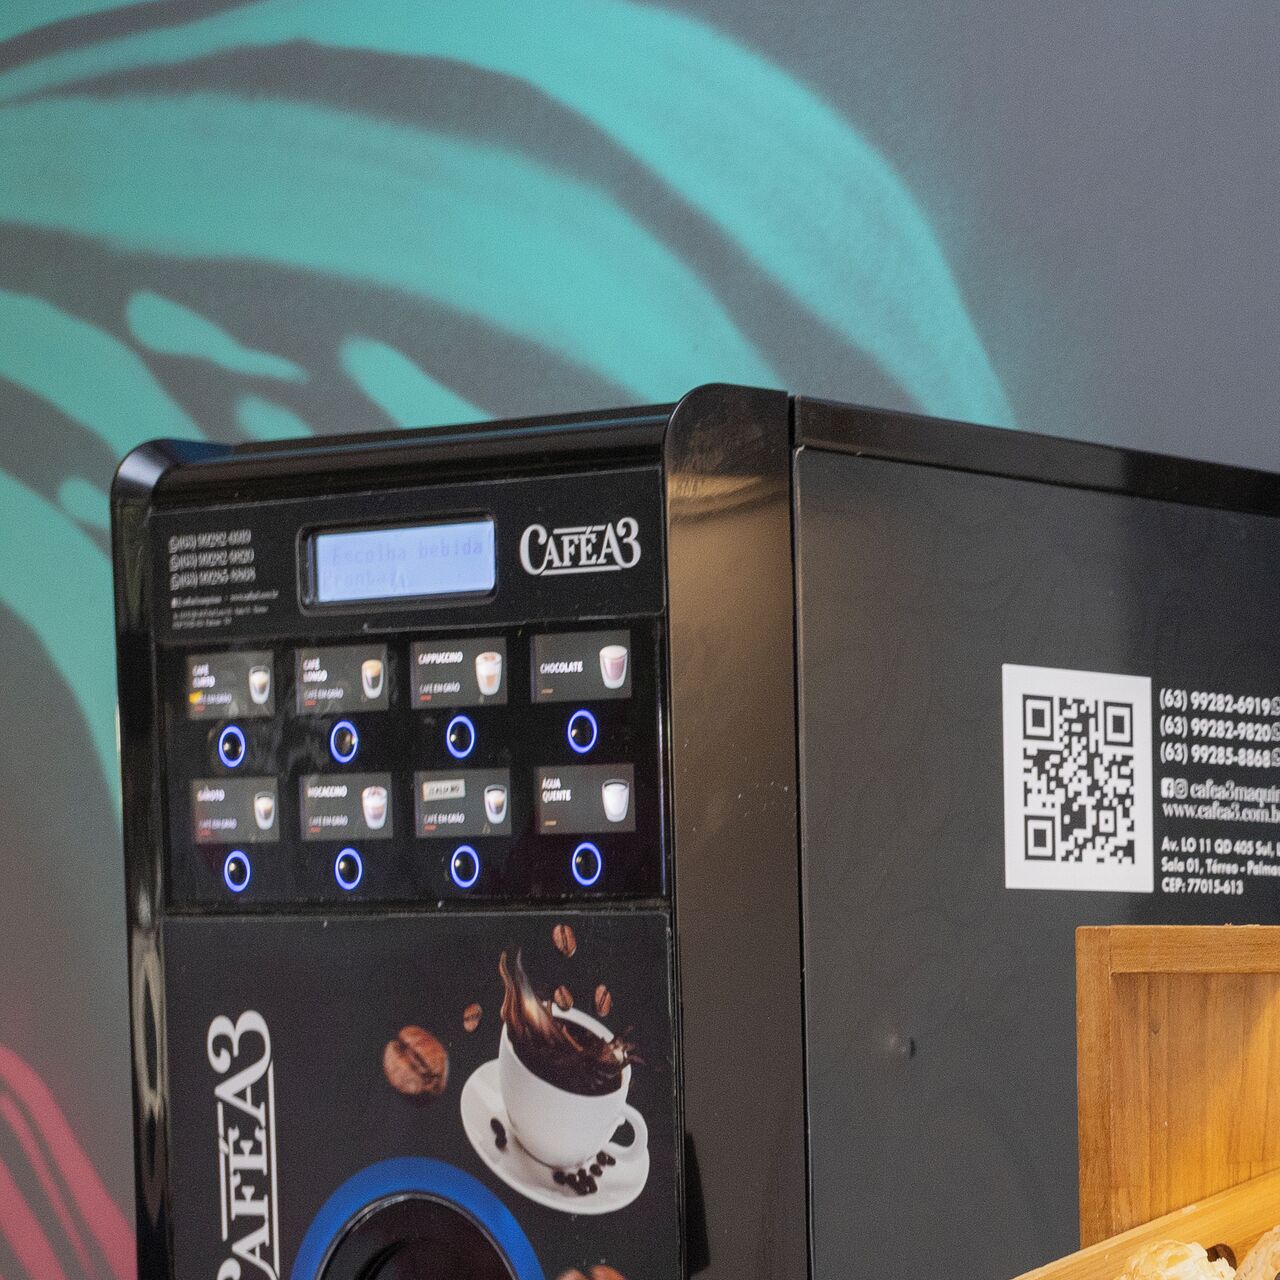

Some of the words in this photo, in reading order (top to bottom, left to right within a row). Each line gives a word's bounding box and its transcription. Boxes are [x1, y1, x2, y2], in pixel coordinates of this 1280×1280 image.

[418, 651, 463, 665] CAPPUCCINO
[540, 660, 583, 675] CHOCOLATE
[1159, 688, 1188, 712] (63)
[1190, 691, 1271, 717] 99282-6919
[1160, 715, 1188, 739] (63)
[1190, 717, 1272, 742] 99282-9820
[1160, 741, 1189, 765] (63)
[542, 789, 572, 803] QUENTE
[1161, 836, 1179, 852] Av.
[1181, 837, 1197, 852] LO
[1199, 838, 1211, 853] 11
[1214, 838, 1233, 855] QD
[1234, 839, 1254, 855] 405
[1161, 856, 1185, 873] Sala
[1161, 877, 1186, 893] CEP:
[1187, 878, 1244, 895] 77015-613
